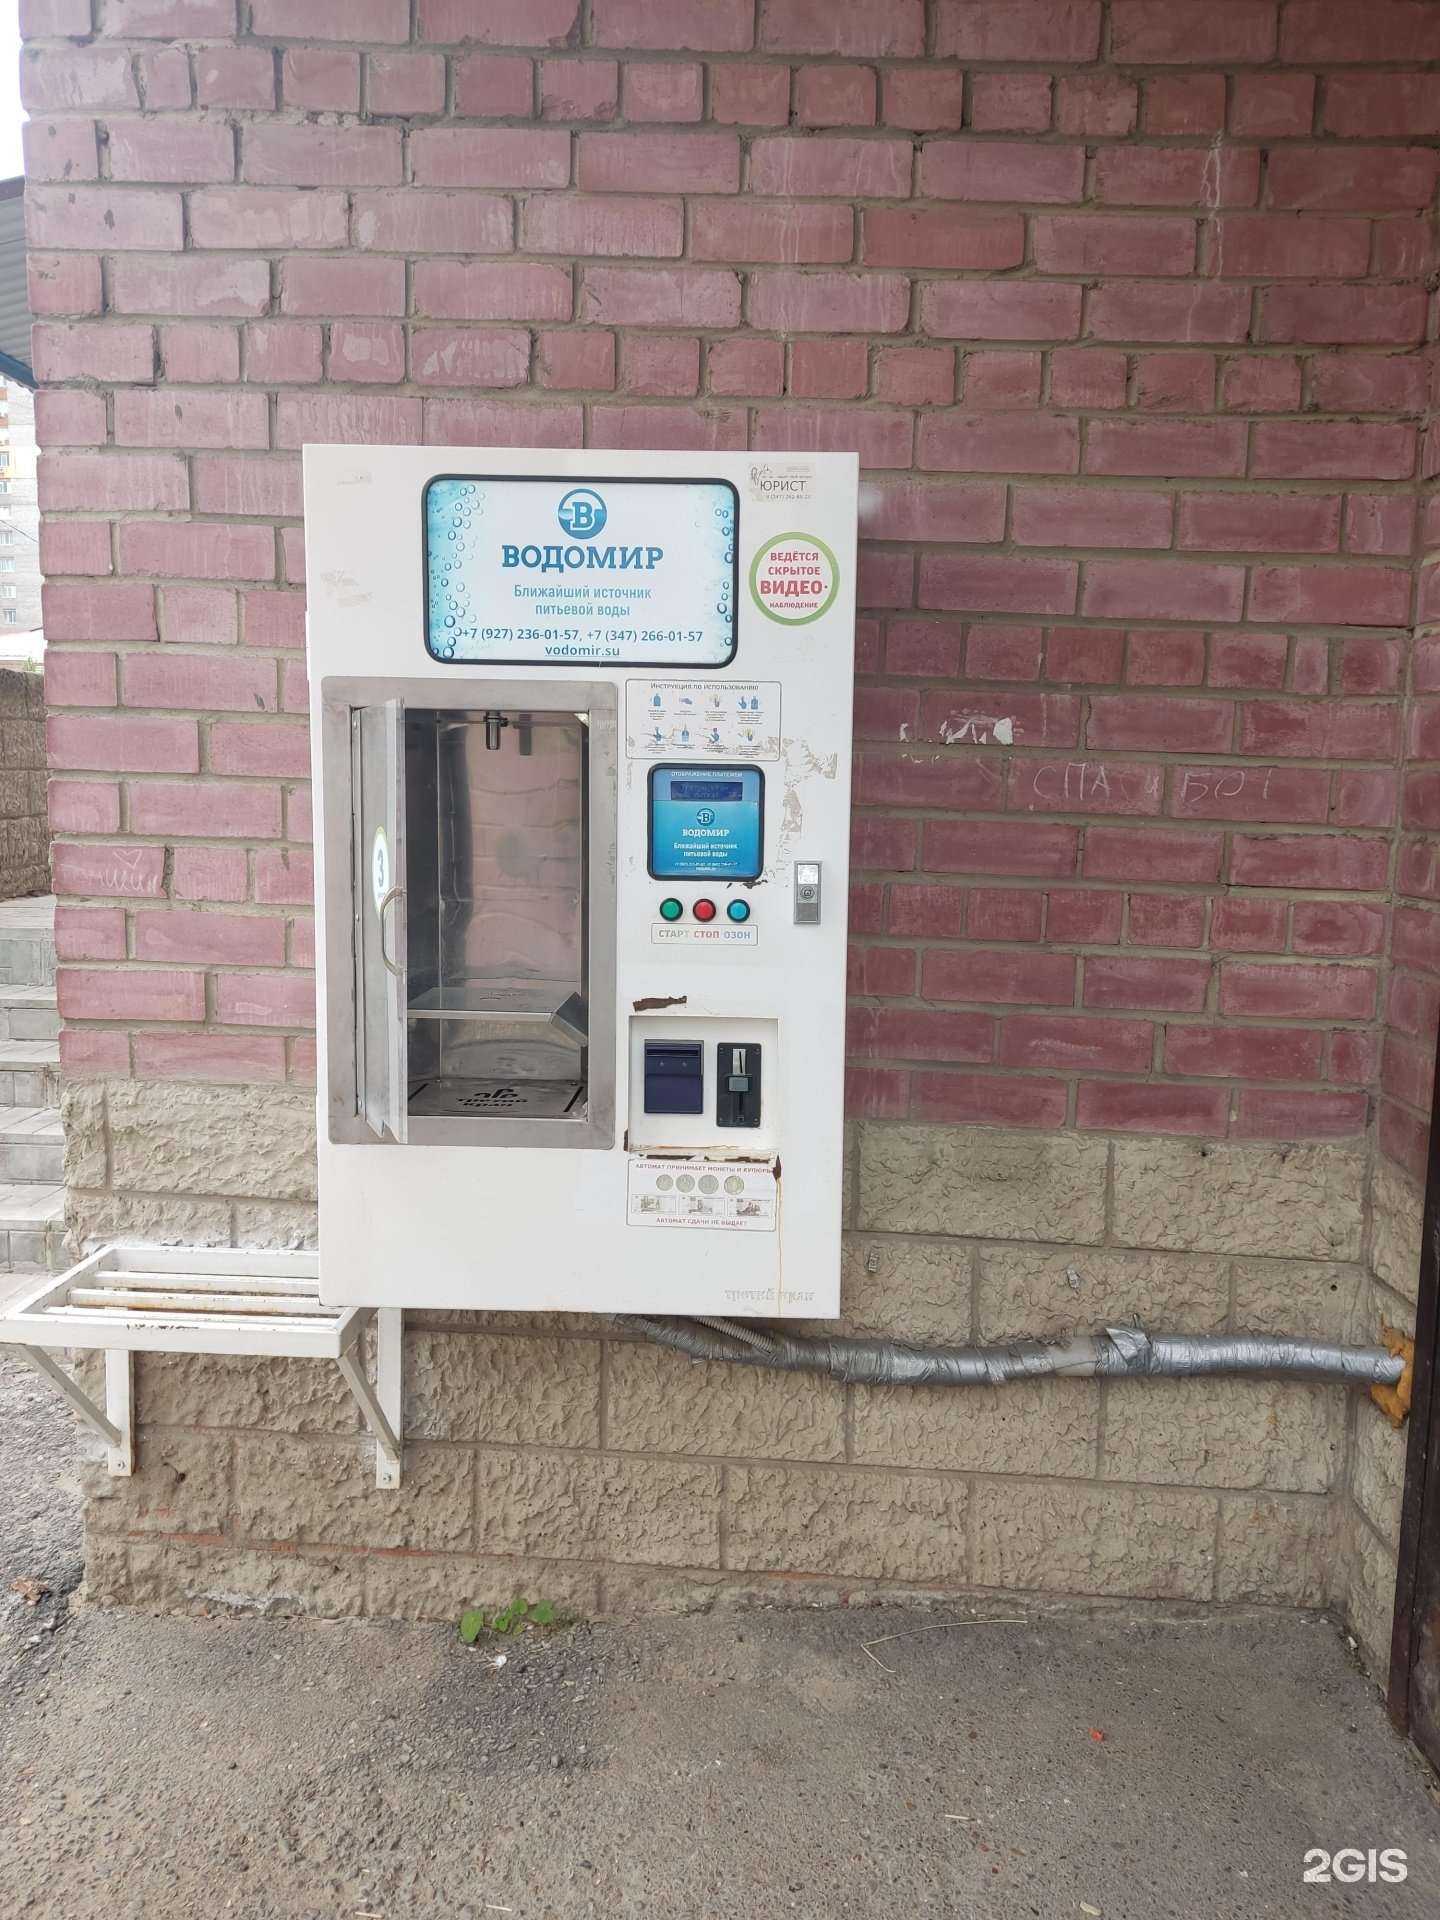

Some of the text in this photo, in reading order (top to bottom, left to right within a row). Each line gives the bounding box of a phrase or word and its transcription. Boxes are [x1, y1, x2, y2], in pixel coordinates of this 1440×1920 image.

[760, 480, 807, 491] ЮРИСТ
[502, 544, 664, 573] ВОДОМИР
[770, 550, 819, 562] ВЕДЁТСЯ
[768, 566, 821, 576] СКРЫТОЕ
[513, 584, 652, 599] Ближайший источник
[535, 603, 631, 618] питьевой воды
[769, 601, 819, 609] НАБЛЮДЕНИЕ
[462, 628, 703, 642] +7 (927) 236-01-57, +7 (347) 266-01-57
[545, 644, 620, 656] vodomir.su
[682, 828, 730, 838] ВОДОМИР
[377, 849, 384, 887] 3
[694, 931, 720, 939] СТОП
[723, 931, 751, 939] ОЗОН
